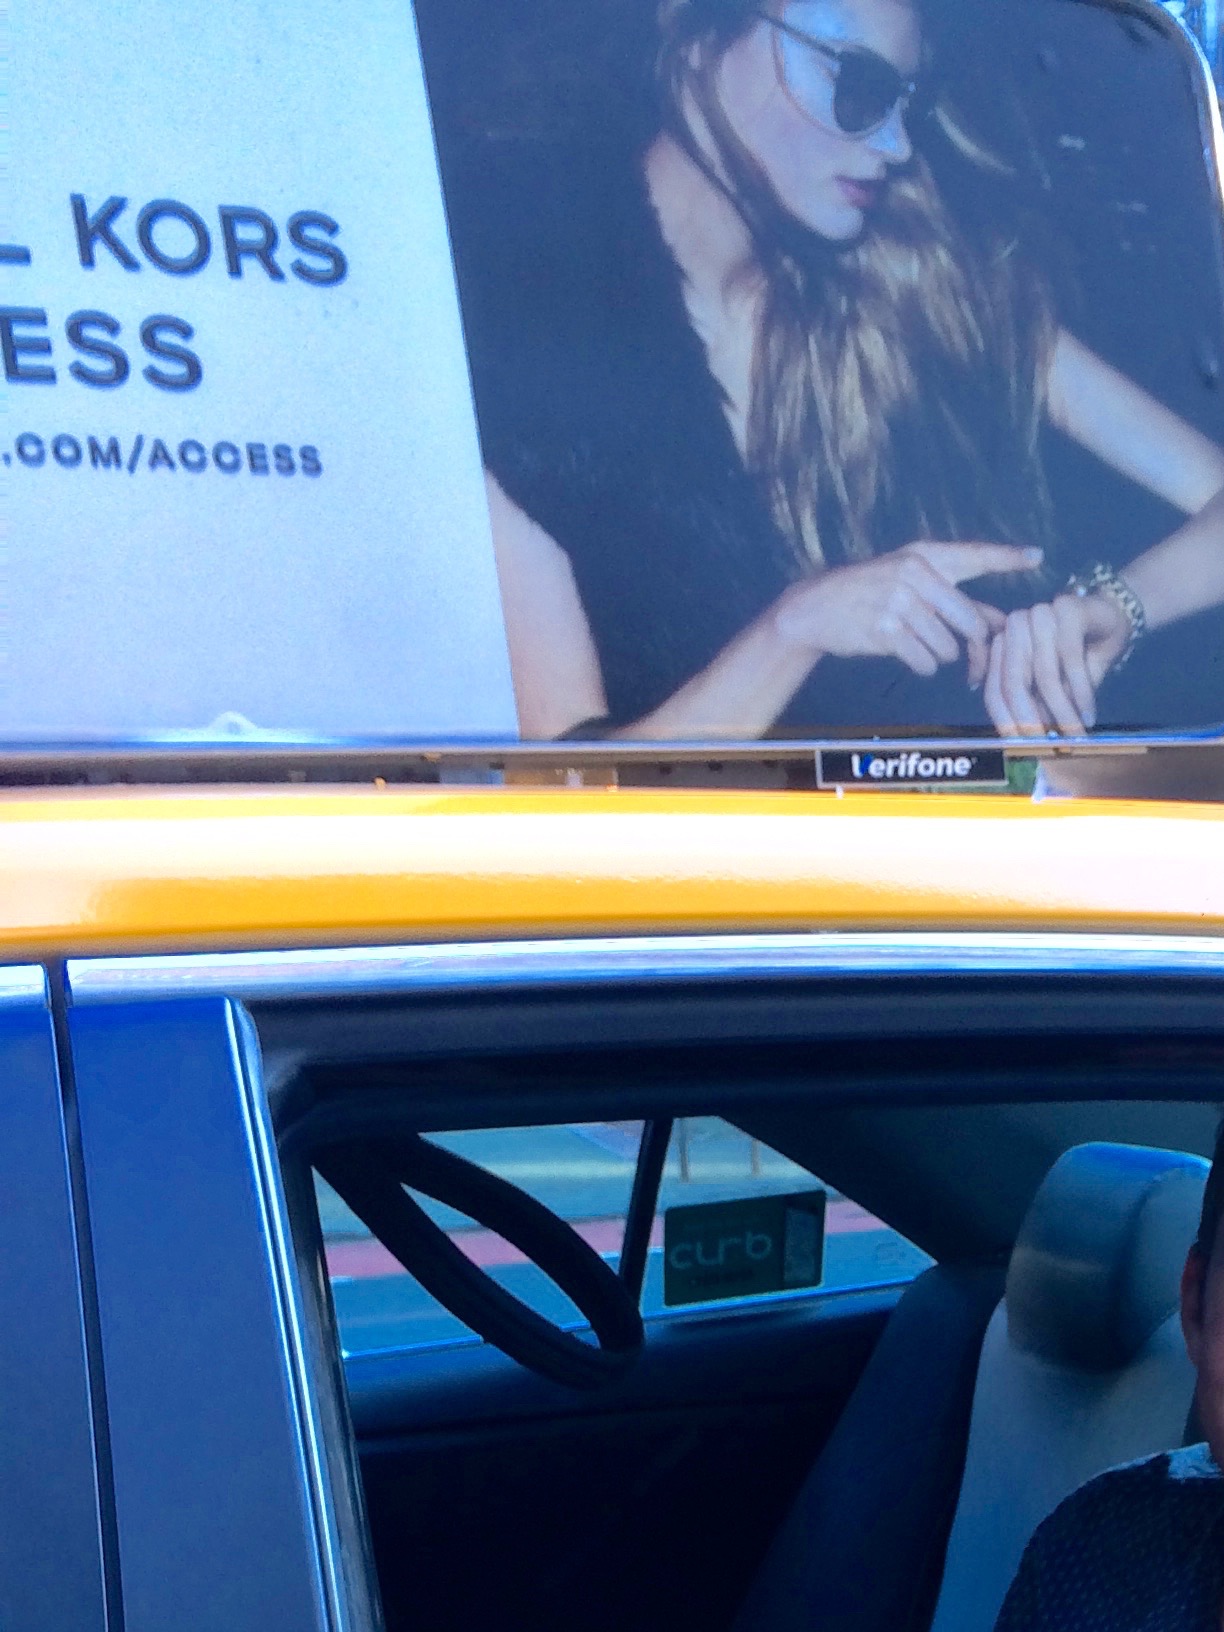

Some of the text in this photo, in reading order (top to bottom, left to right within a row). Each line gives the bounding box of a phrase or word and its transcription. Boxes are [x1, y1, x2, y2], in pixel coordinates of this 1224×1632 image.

[69, 192, 350, 289] KORS
[0, 306, 204, 394] ESS
[851, 752, 972, 779] Verifone
[669, 1231, 772, 1270] curb
